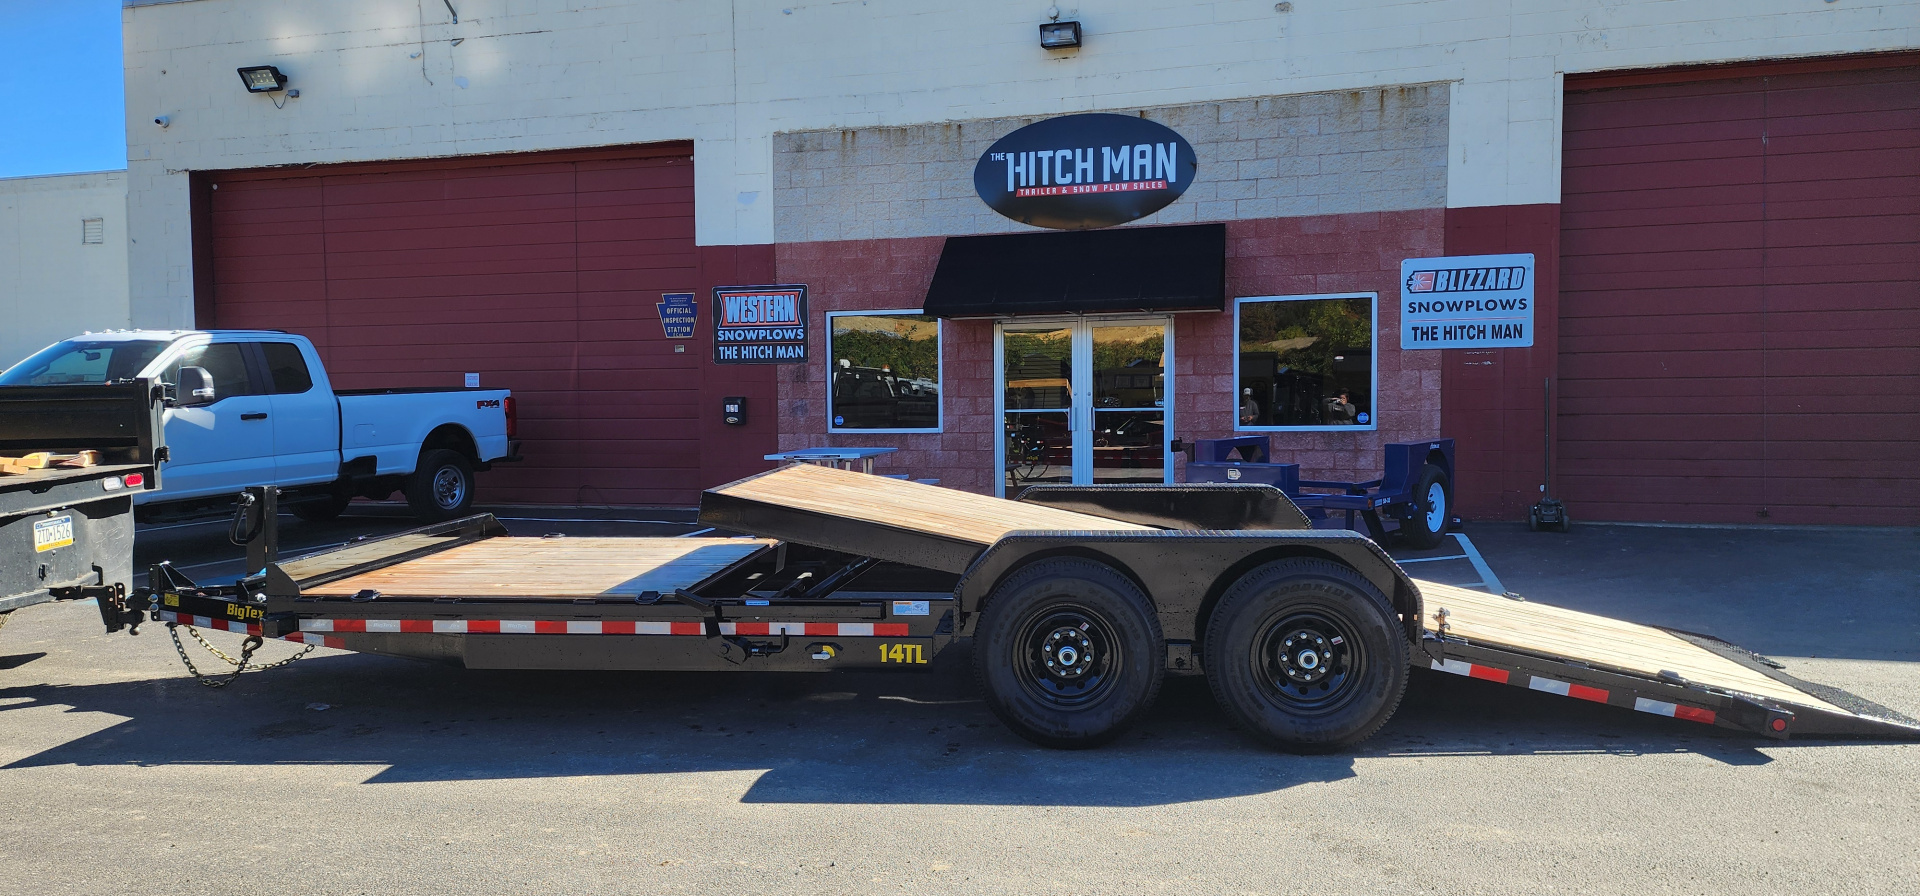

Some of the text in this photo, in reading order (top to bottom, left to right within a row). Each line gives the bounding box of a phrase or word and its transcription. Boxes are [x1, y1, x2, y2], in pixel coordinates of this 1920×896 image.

[990, 142, 1177, 192] THE HITCH MAN
[1020, 181, 1163, 196] TRAILER & SNOW PLOW SALES
[1436, 267, 1525, 292] BLIZZARD
[724, 294, 795, 324] WESTERN
[1408, 298, 1527, 313] SNOWPLOWS
[663, 316, 695, 324] INSPECTION
[717, 328, 805, 341] SNOWPLOWS
[1411, 323, 1523, 341] THE HITCH MAN
[718, 345, 804, 360] THE HITCH MAN
[476, 399, 500, 409] FX4
[226, 602, 265, 620] BigTex
[878, 643, 928, 664] 14TL
